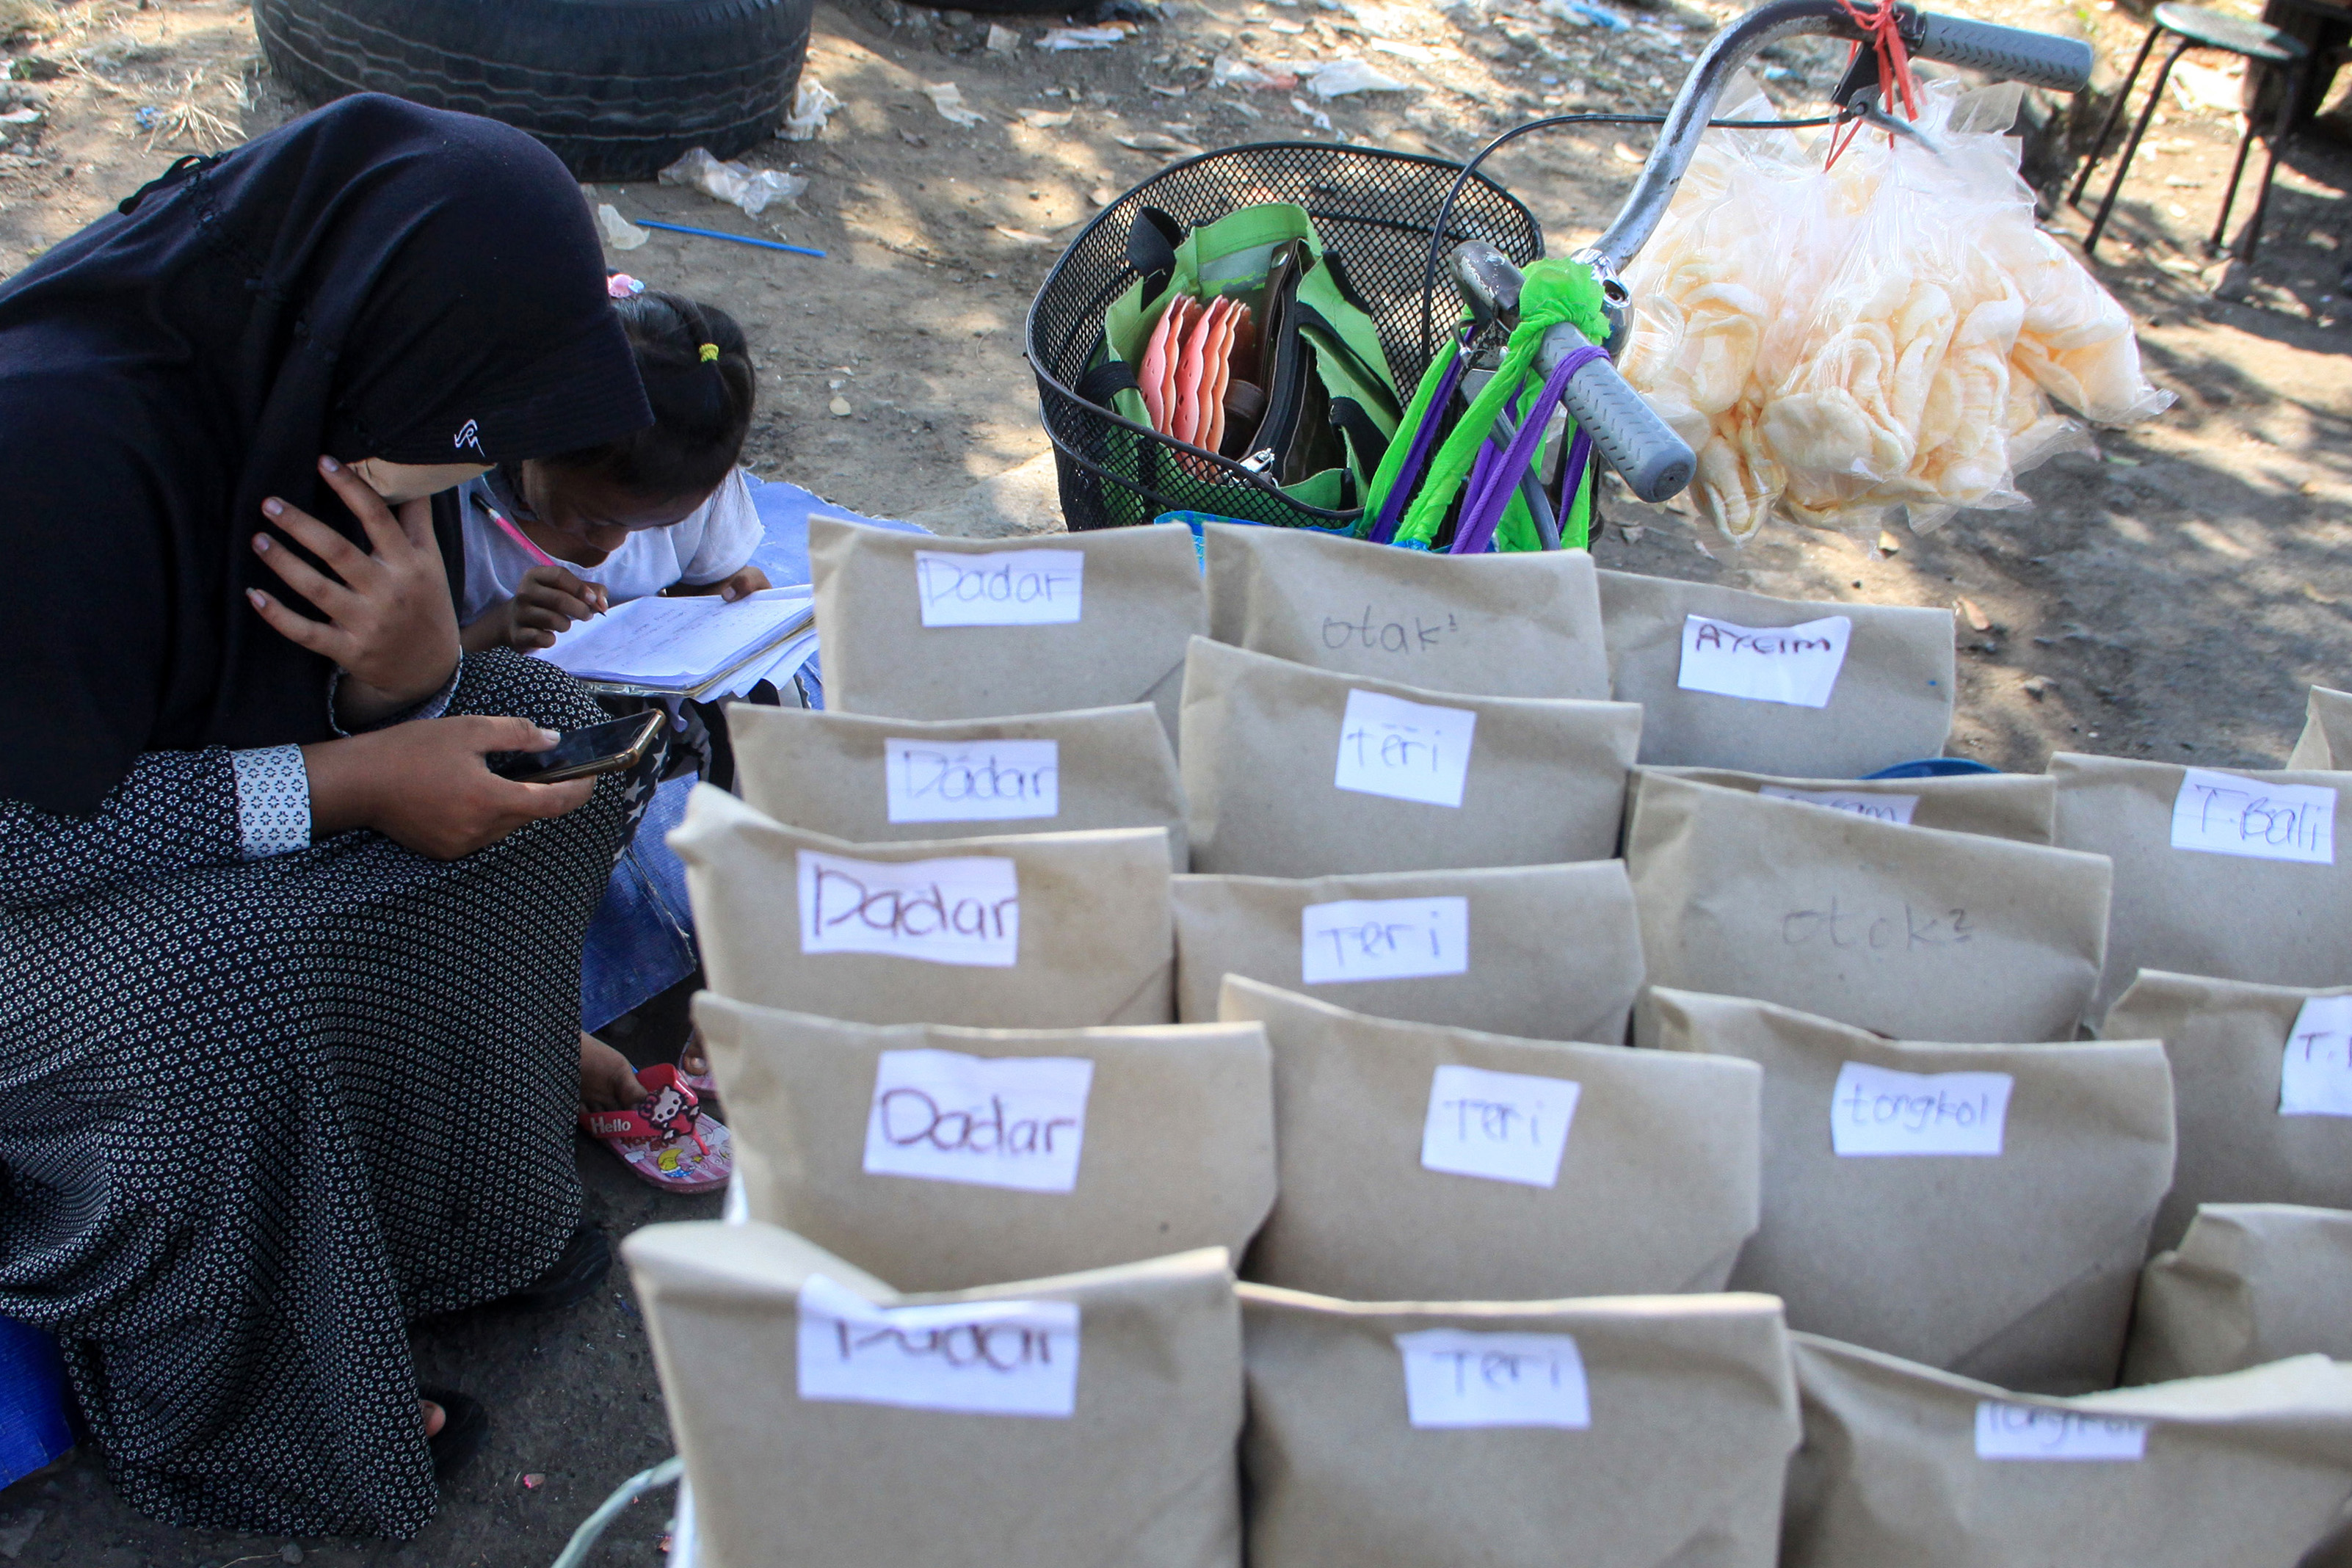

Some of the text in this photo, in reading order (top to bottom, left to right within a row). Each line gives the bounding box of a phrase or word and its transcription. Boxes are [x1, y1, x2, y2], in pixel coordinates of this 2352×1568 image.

[918, 558, 1074, 607] Dadar
[815, 865, 1018, 938] Dadar
[590, 1117, 631, 1134] Hello
[882, 1088, 1077, 1154] Dadar
